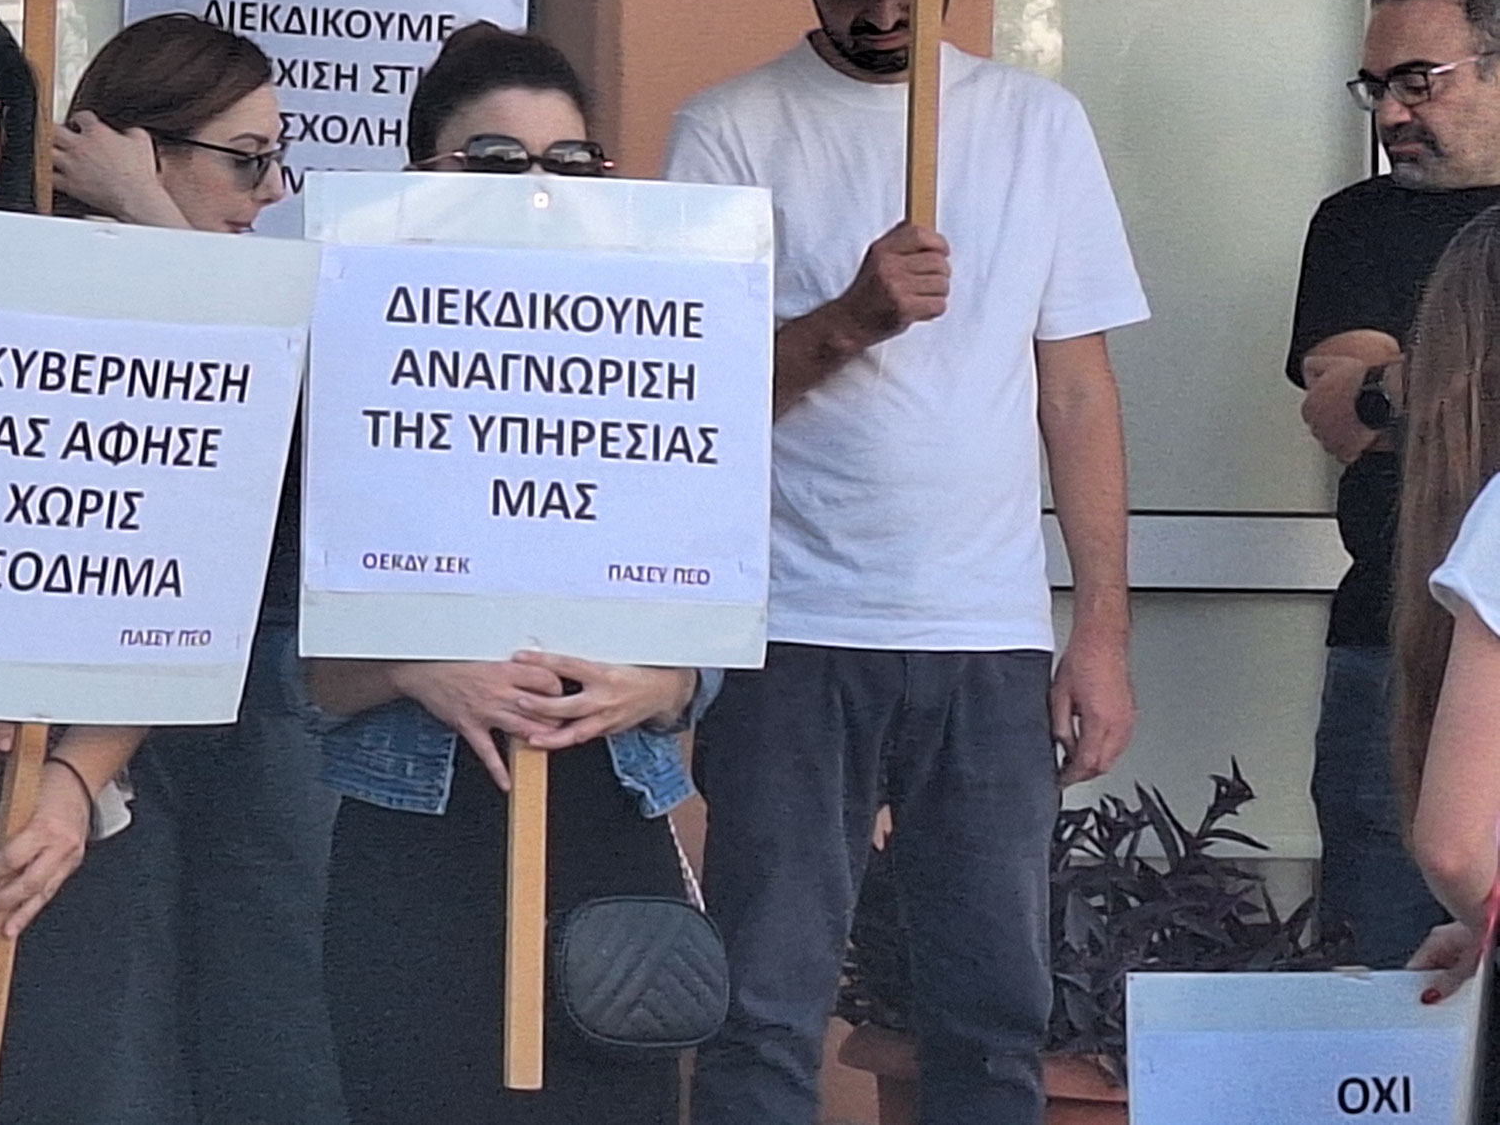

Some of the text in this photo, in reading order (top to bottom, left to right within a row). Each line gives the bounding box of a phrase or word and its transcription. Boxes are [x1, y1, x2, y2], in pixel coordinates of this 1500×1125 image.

[371, 64, 424, 95] ΣΤ
[386, 286, 704, 339] ΔΙΕΚΔΙΚΟΥΜΕ
[391, 348, 695, 401] ΑΝΑΓΝΩΡΙΣΗ
[60, 421, 222, 468] ΑΦΗΣΕ
[362, 409, 719, 465] ΤΗΣ ΥΠΗΡΕΣΙΑΣ
[4, 483, 144, 531] ΧΩΡΙΣ
[492, 479, 598, 521] ΜΑΣ
[362, 552, 470, 574] ΟΕΚΔΥ ΣΕΚ
[608, 564, 711, 586] ΠΑΣΕΥ ΠΕΟ
[120, 629, 175, 646] ΠΑΣΕΥ
[1337, 1076, 1411, 1115] ΟΧΙ
